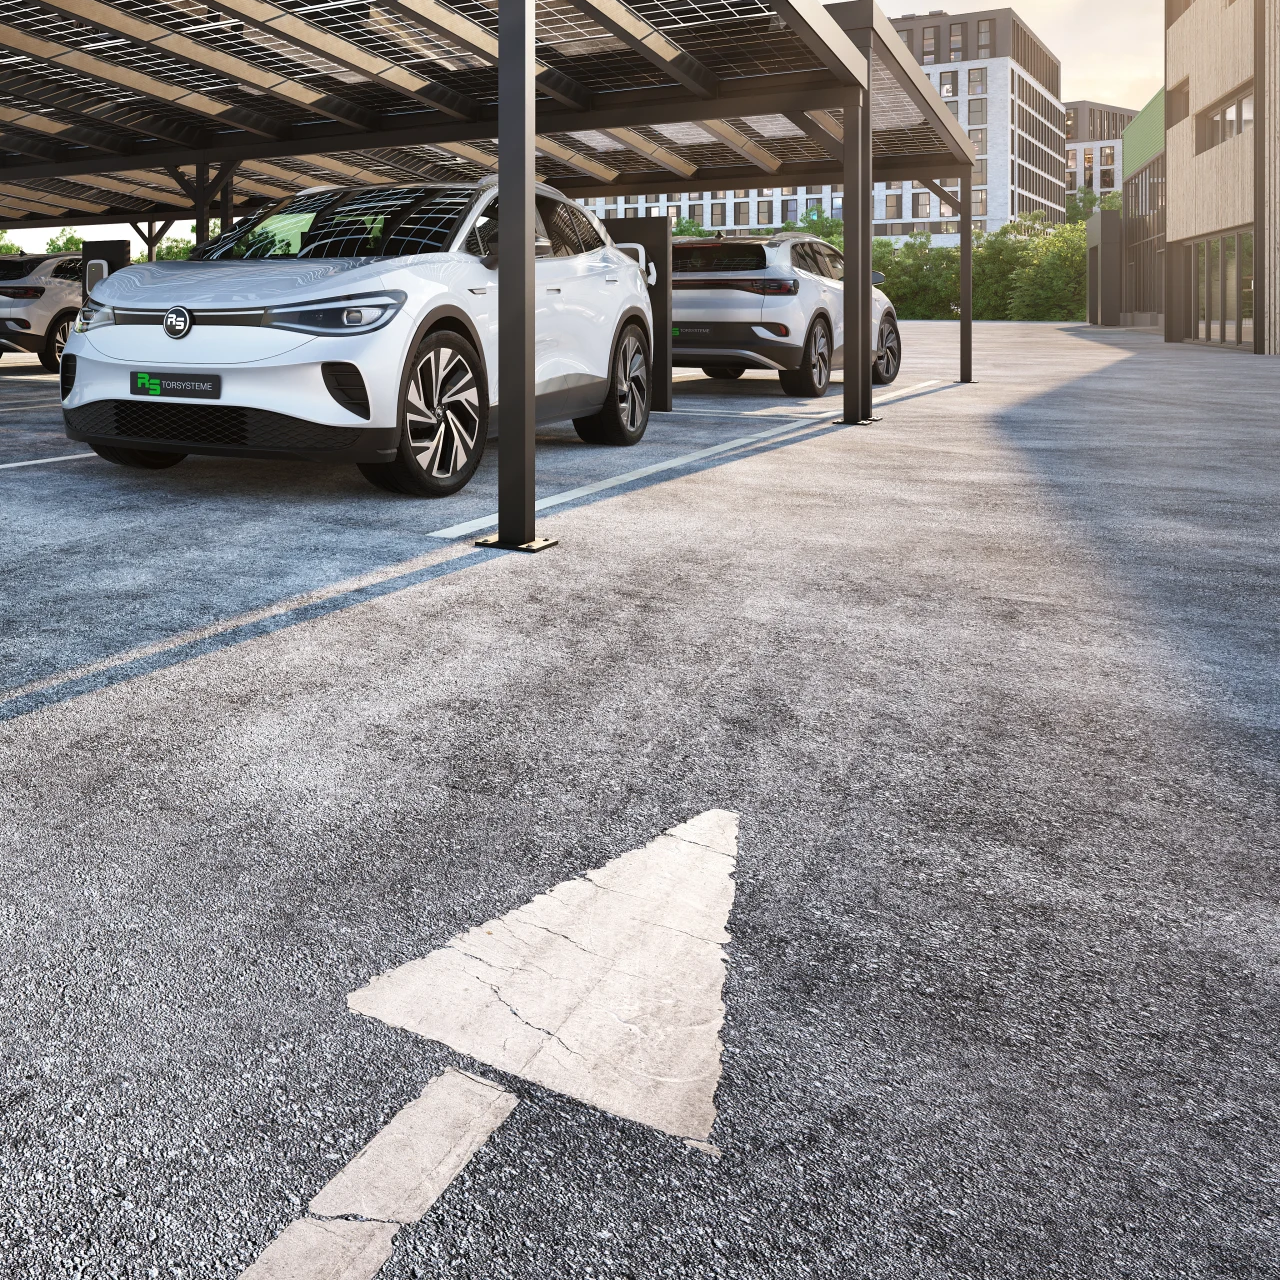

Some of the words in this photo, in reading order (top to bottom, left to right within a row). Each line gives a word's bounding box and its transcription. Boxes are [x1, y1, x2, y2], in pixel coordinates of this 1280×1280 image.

[167, 314, 184, 329] RS
[137, 373, 160, 395] RS
[161, 380, 213, 391] TORSYSTEME
